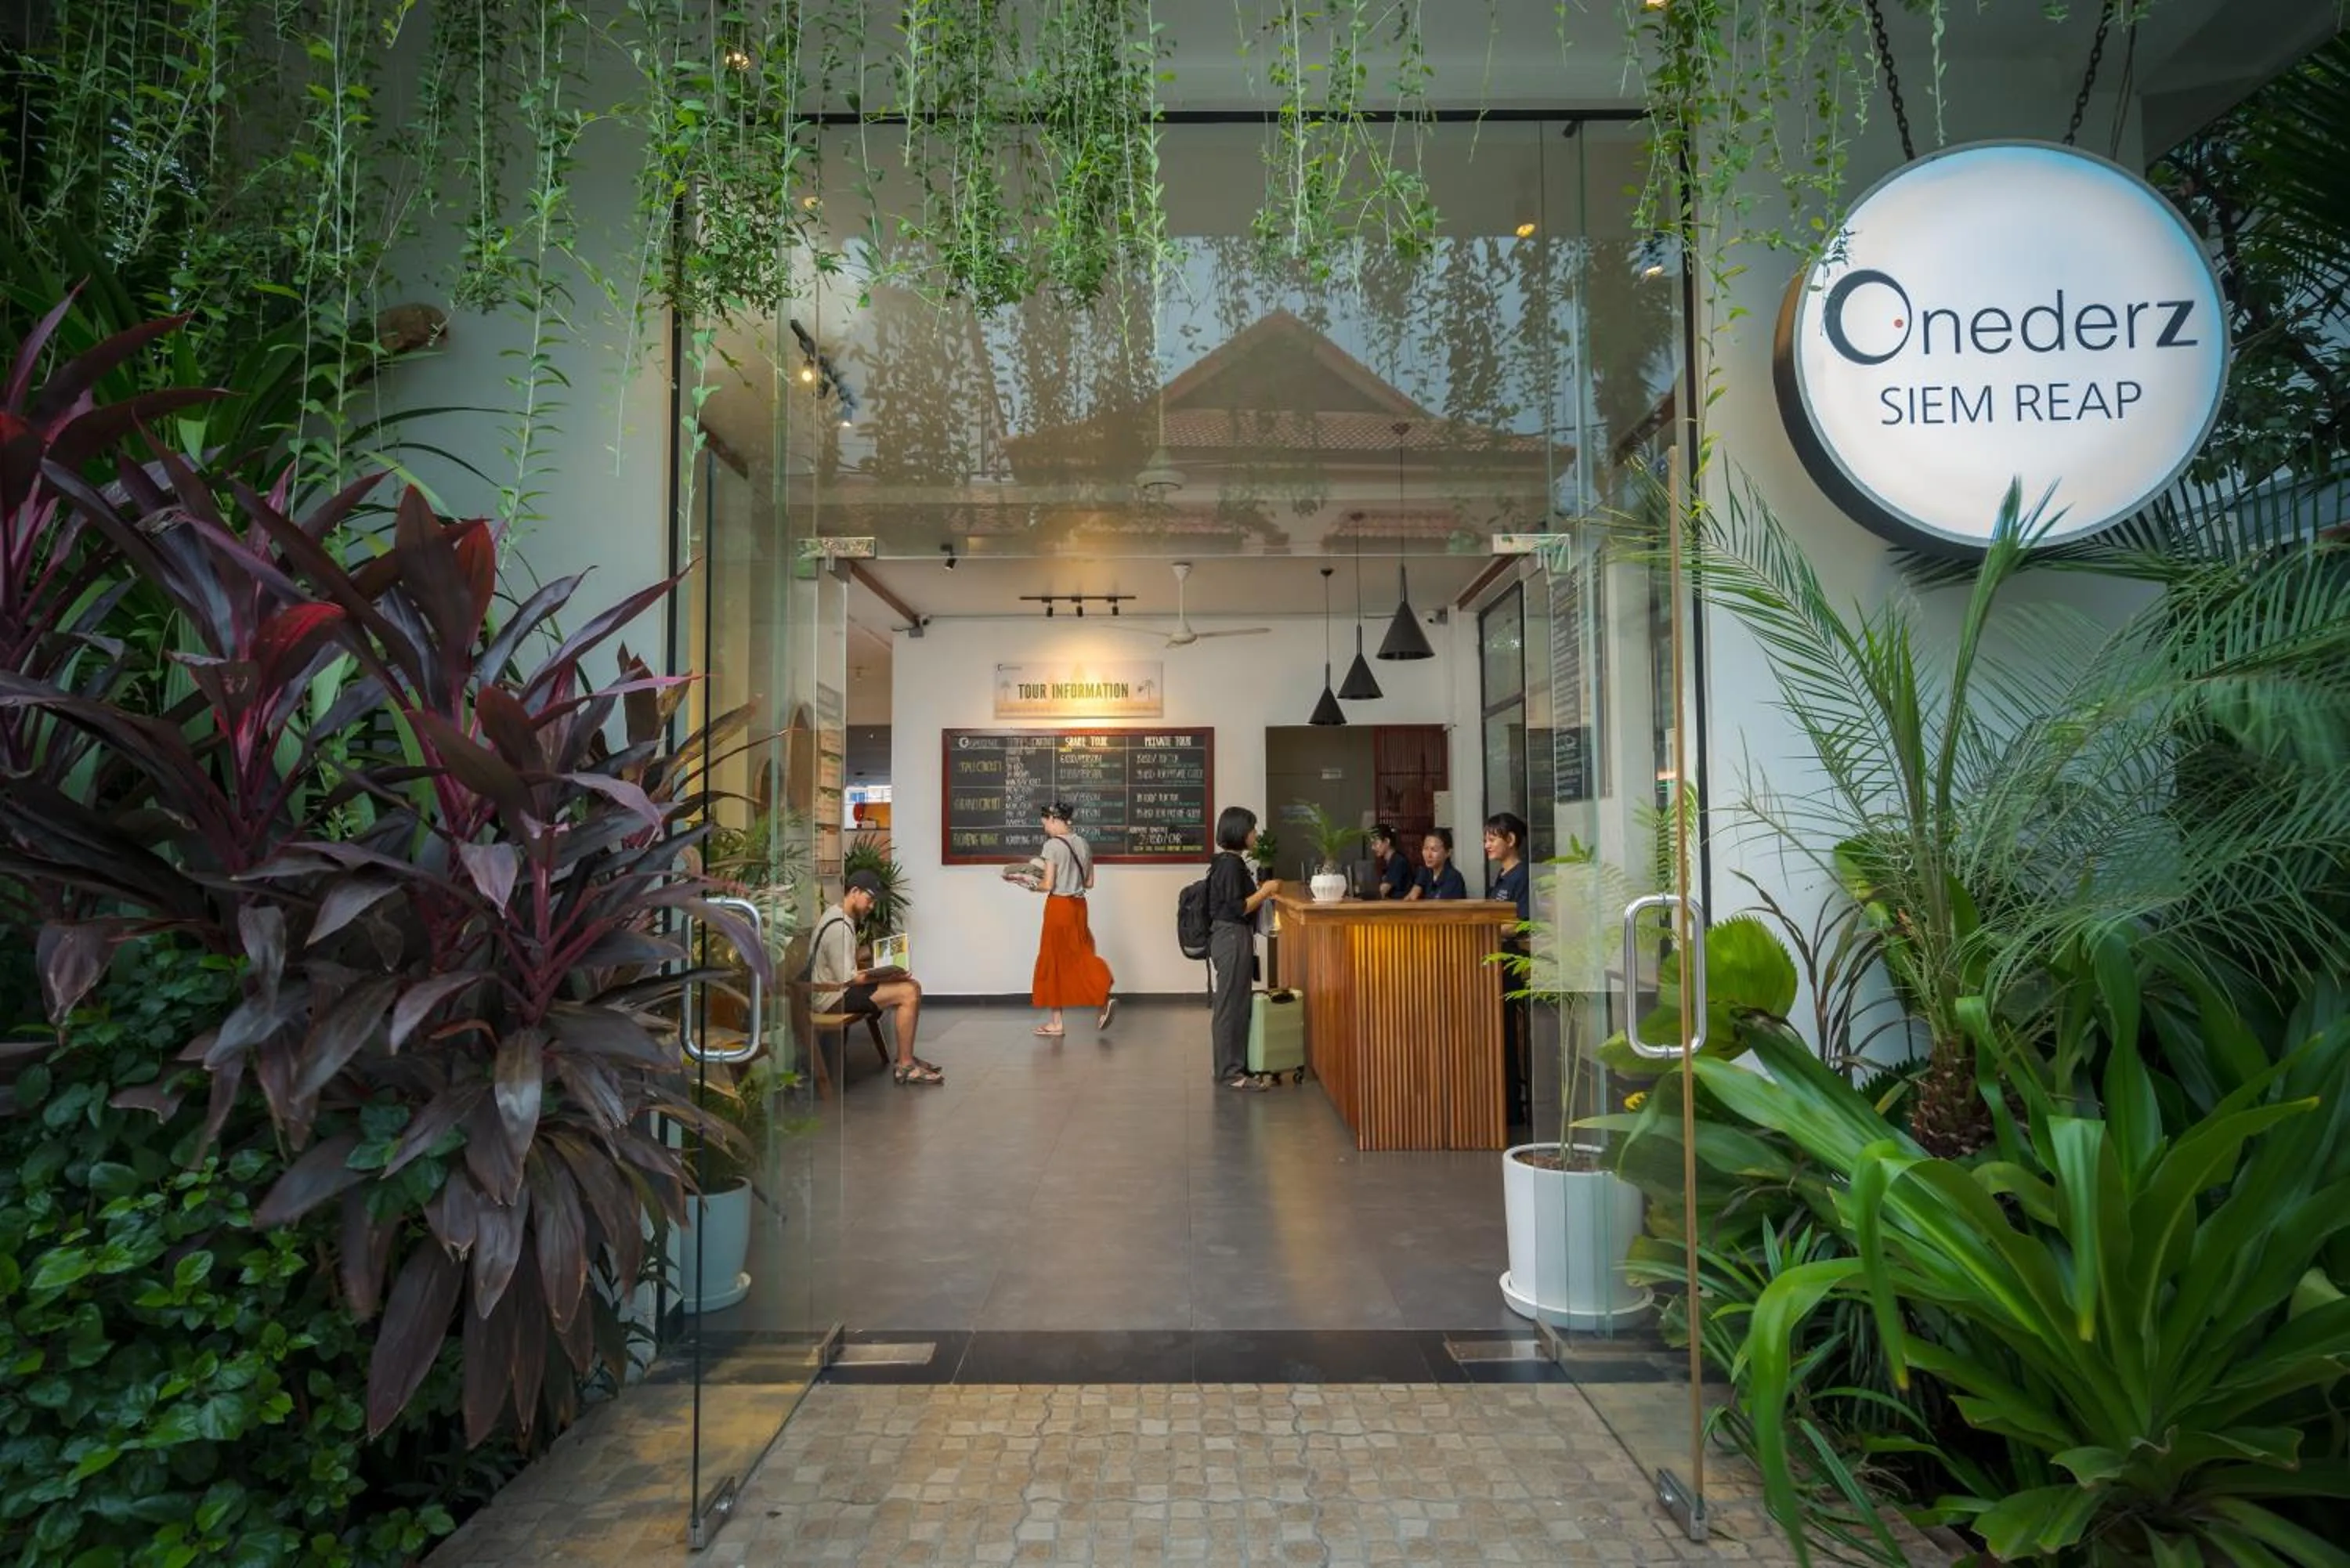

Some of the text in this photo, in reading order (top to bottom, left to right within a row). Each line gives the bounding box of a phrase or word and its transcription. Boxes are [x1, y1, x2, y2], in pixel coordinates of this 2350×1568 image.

[1824, 269, 2199, 366] Onederz
[1881, 381, 2142, 425] SIEM REAP
[1018, 682, 1129, 699] TOUR INFORMATION
